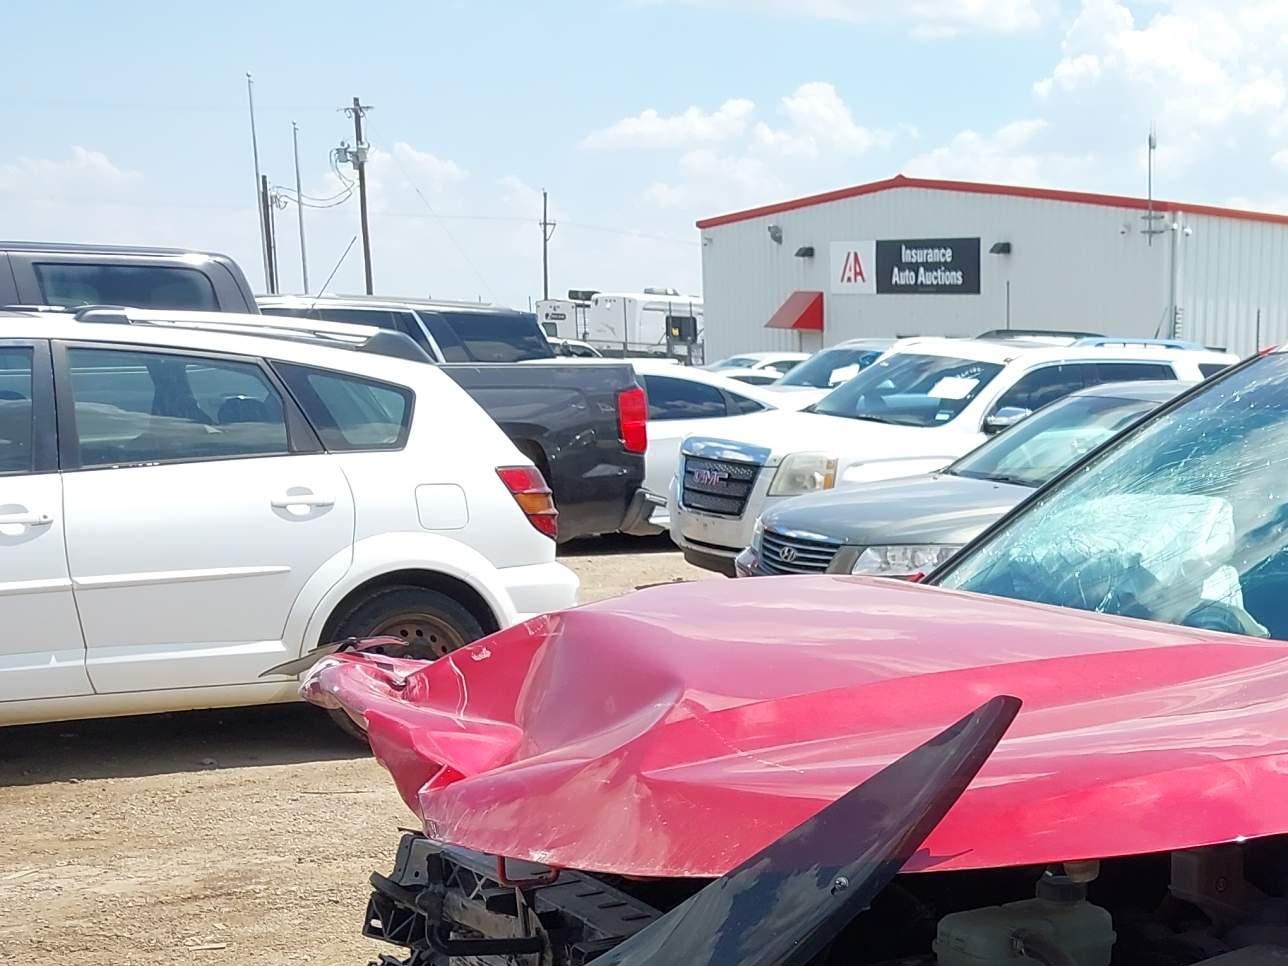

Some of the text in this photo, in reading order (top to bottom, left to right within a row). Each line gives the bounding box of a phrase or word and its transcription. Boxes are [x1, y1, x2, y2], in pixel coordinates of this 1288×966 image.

[901, 244, 952, 263] Insurance
[892, 265, 963, 286] Auto Auctions
